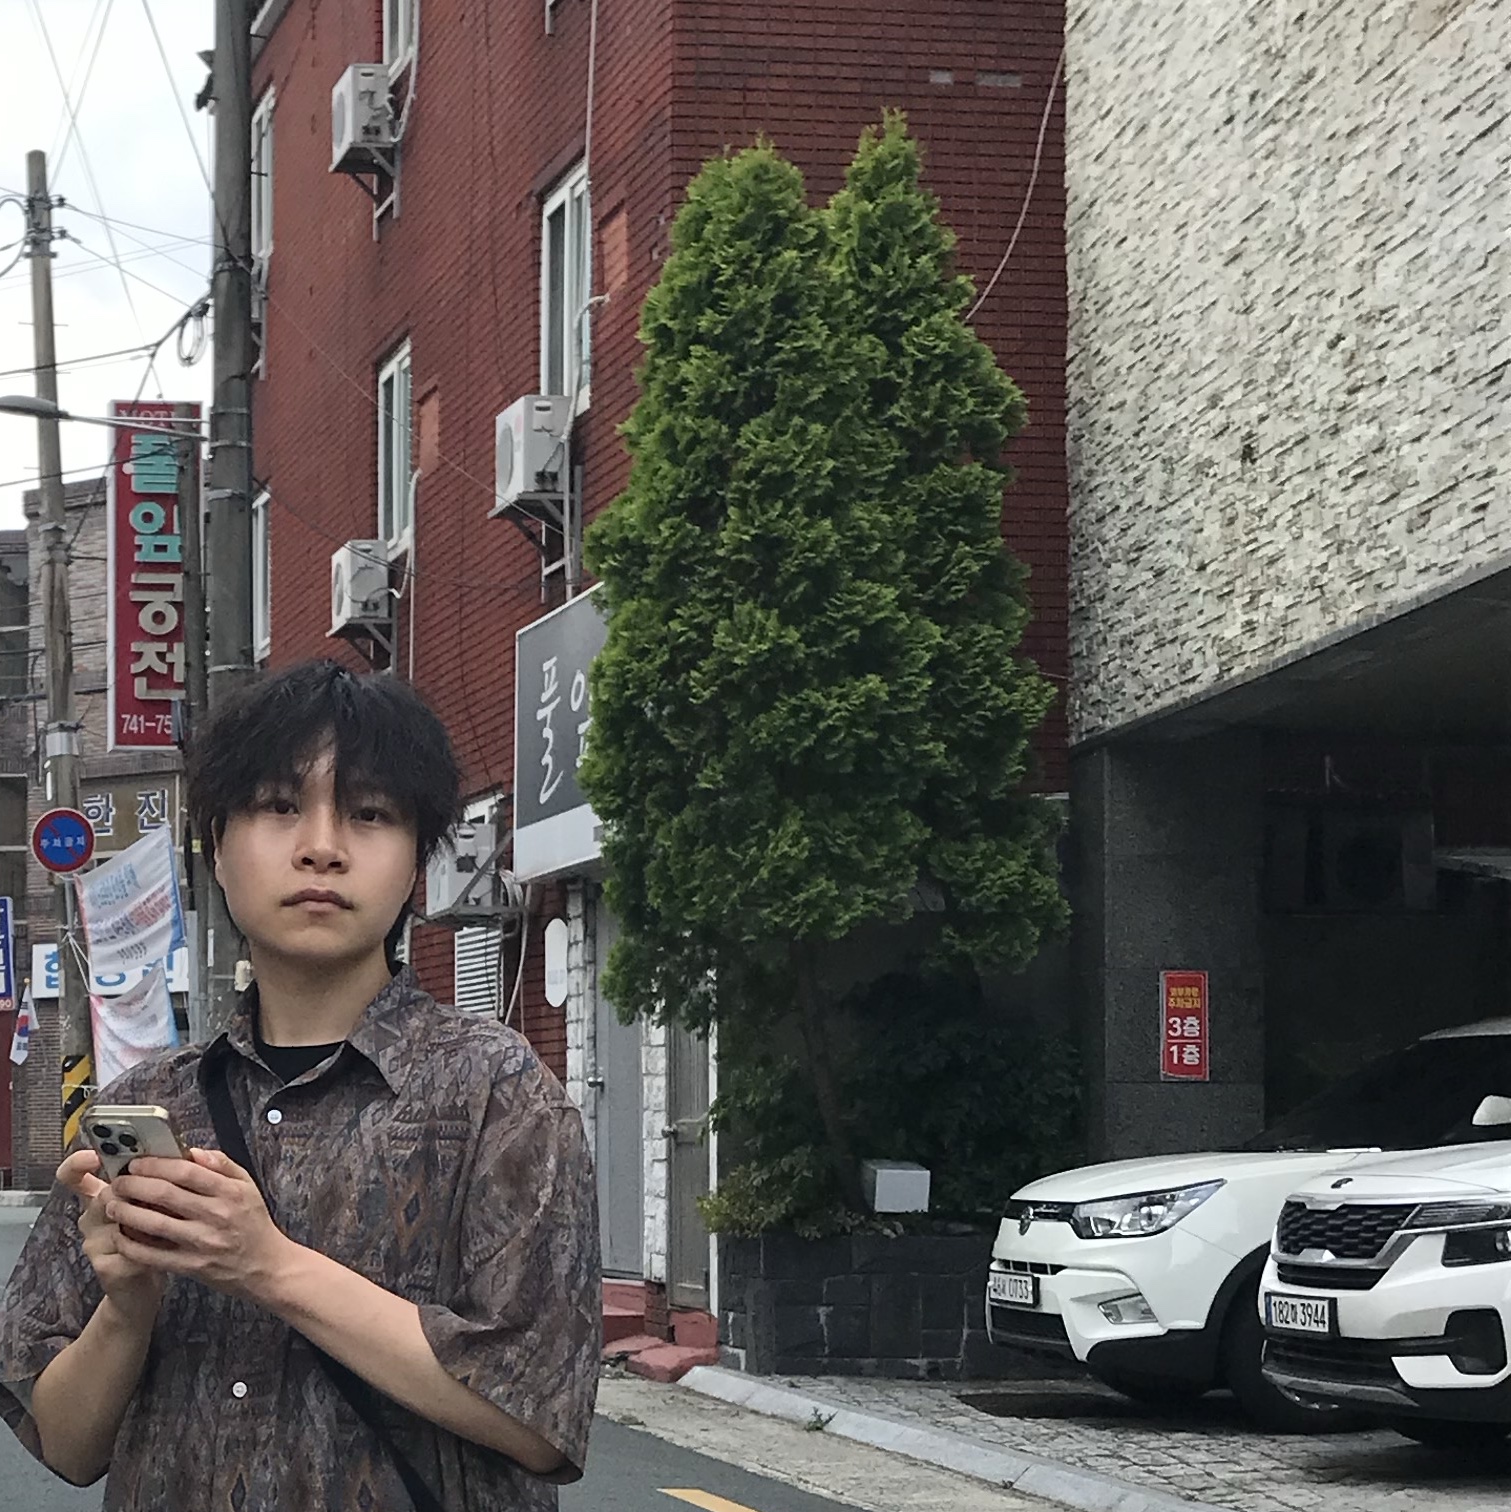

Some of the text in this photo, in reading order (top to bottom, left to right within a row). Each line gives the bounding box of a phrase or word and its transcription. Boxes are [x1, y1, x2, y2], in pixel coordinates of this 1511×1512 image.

[121, 714, 173, 734] 741-75
[1168, 1016, 1201, 1037] 3층
[1169, 1044, 1201, 1066] 1층
[1300, 1302, 1327, 1329] 3944
